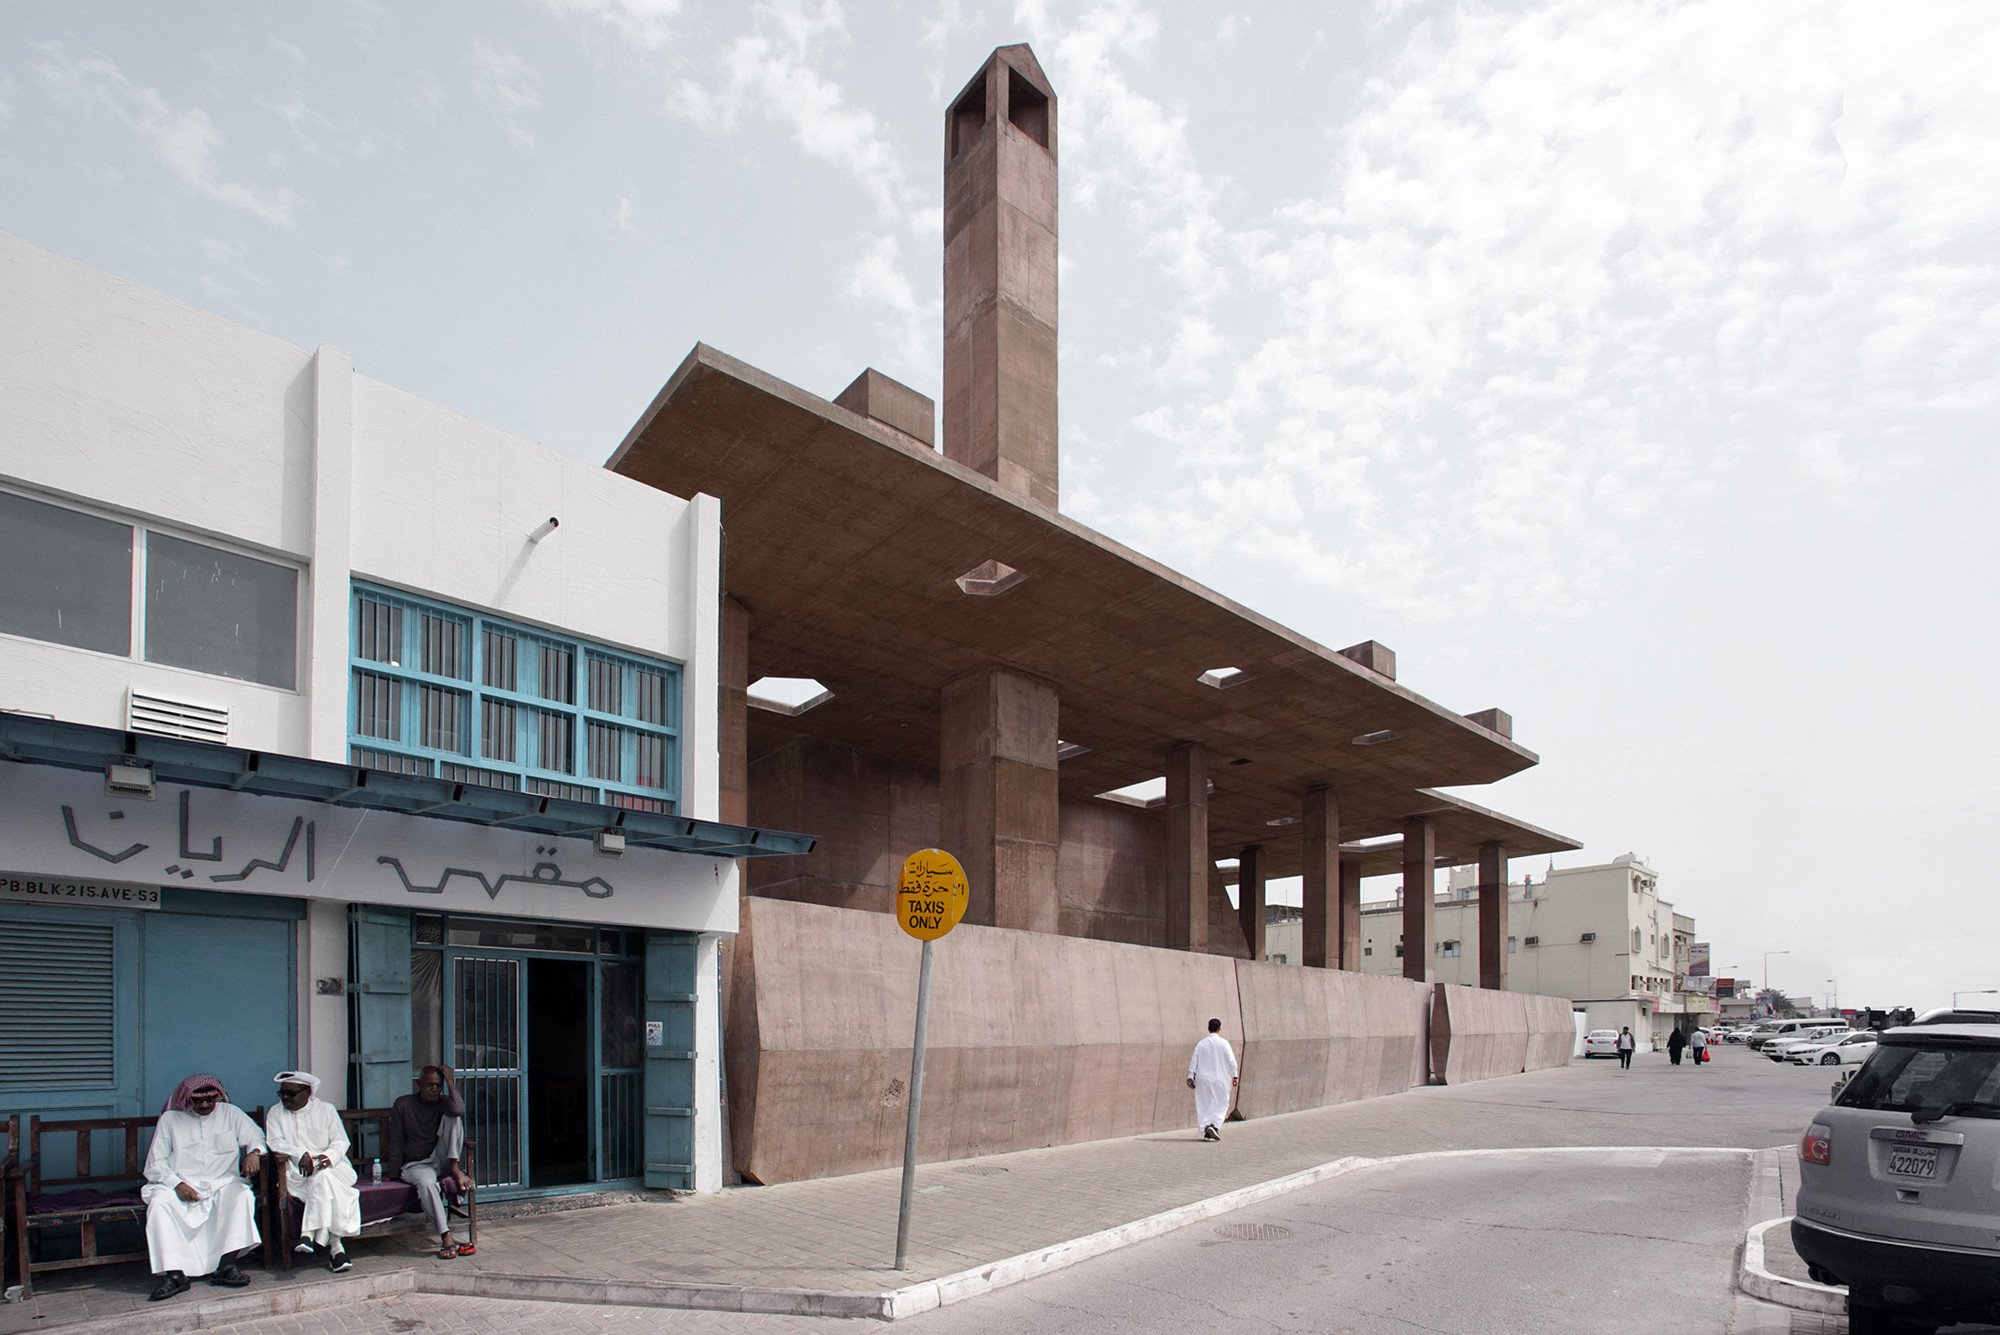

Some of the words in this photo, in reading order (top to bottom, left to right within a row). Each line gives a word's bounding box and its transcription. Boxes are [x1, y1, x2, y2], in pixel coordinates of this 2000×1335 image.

[909, 861, 953, 878] سيارات
[899, 880, 921, 894] فقط
[908, 900, 945, 914] TAXIS
[909, 915, 942, 929] ONLY
[1895, 1130, 1928, 1141] GMC
[1889, 1154, 1935, 1176] 422079
